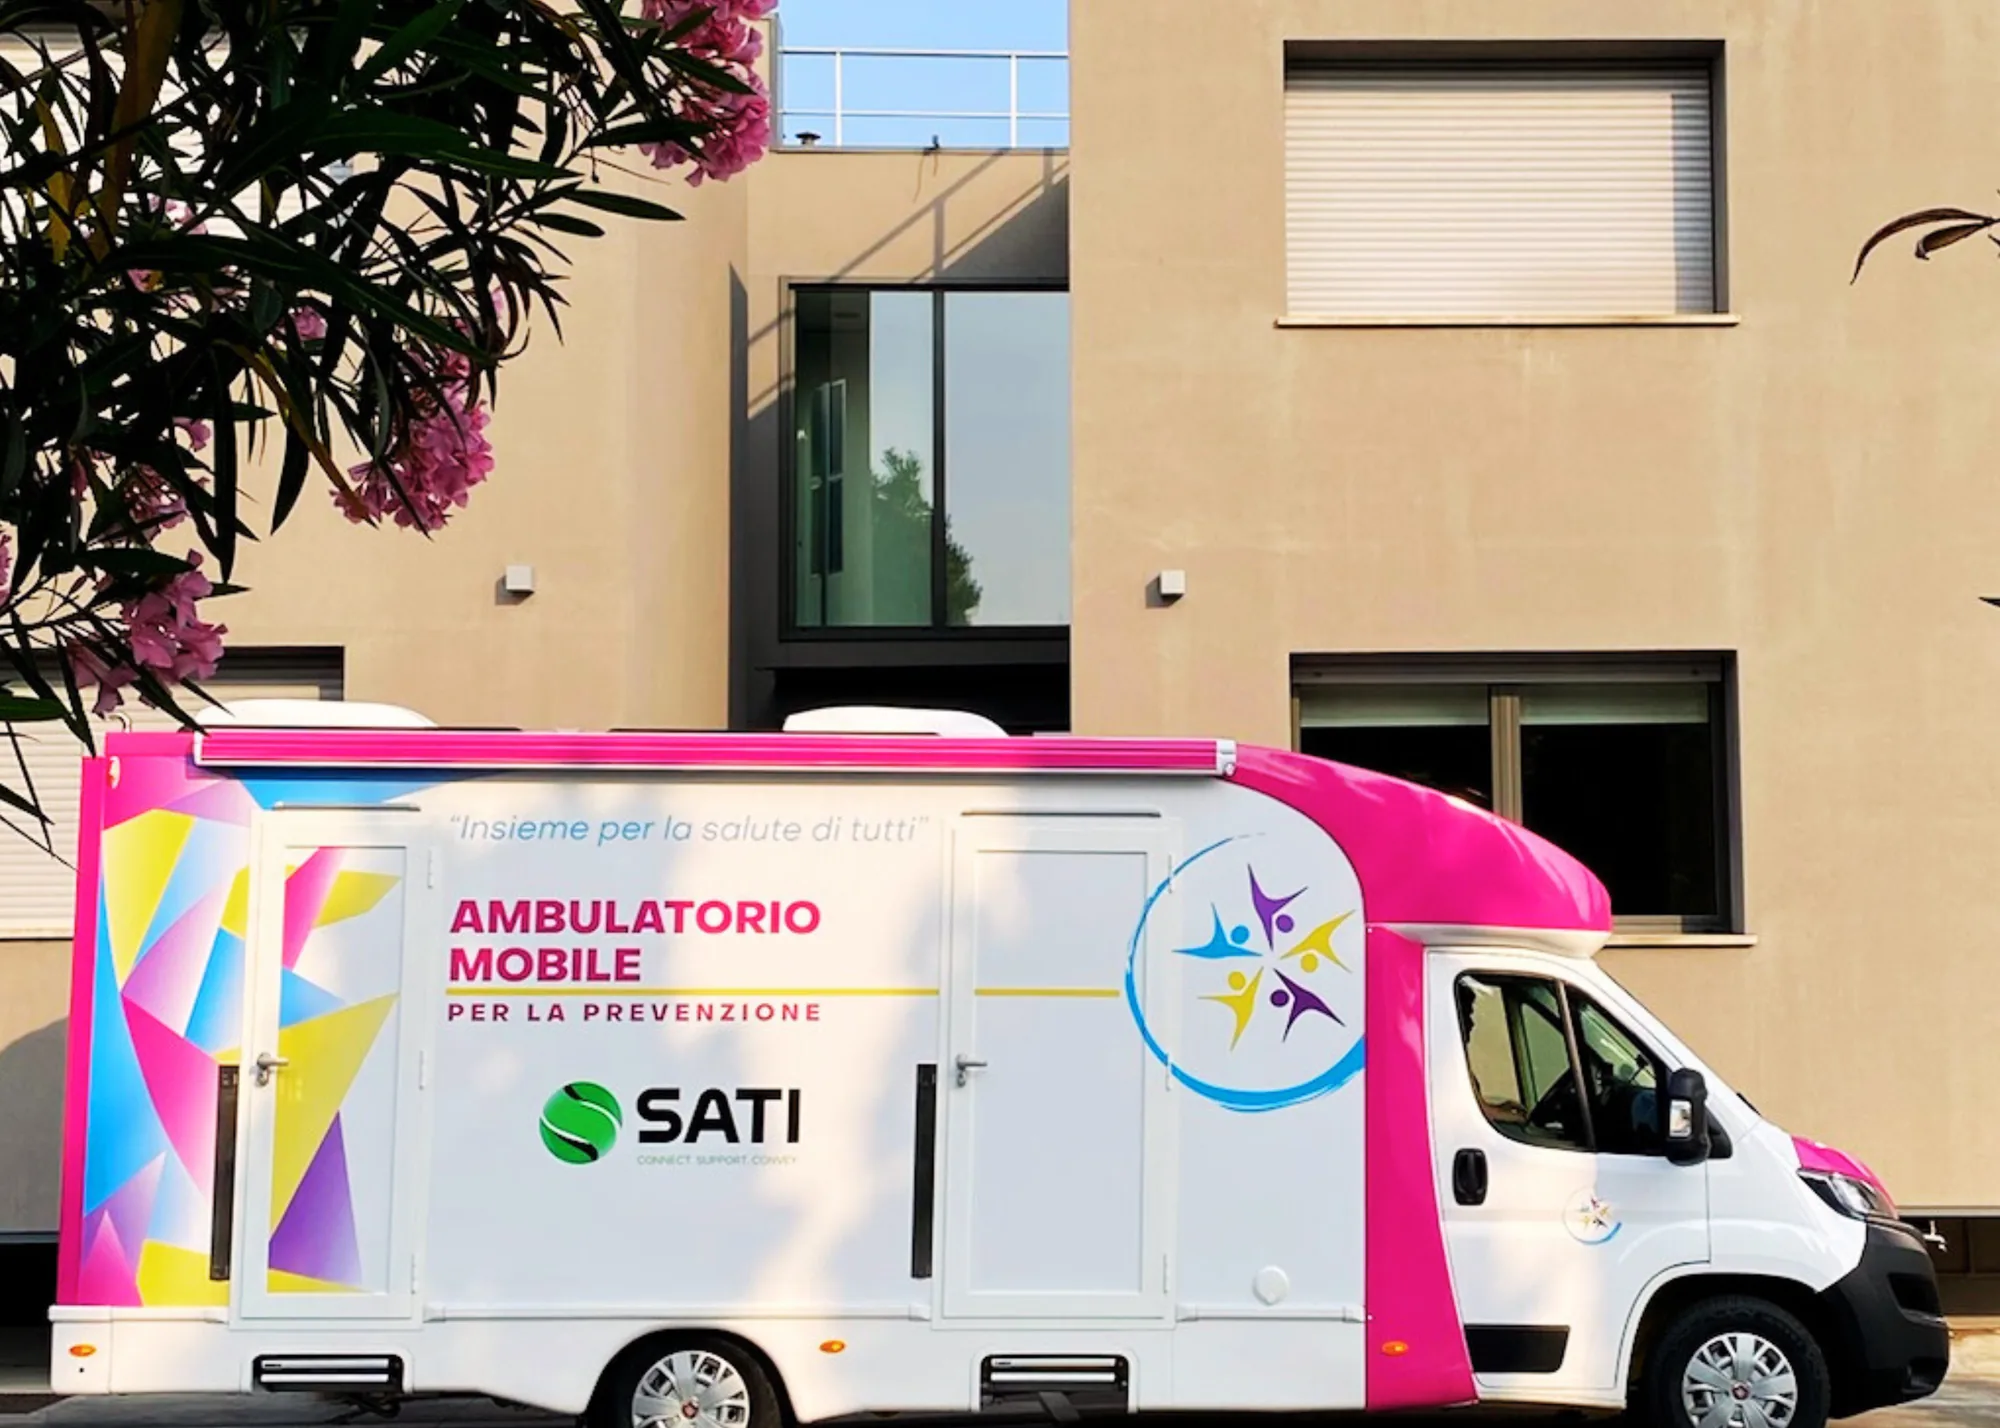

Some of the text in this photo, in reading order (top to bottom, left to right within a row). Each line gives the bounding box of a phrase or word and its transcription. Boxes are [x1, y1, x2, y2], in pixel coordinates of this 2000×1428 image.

[596, 819, 656, 848] per
[663, 814, 693, 841] la
[703, 814, 803, 842] salute
[812, 815, 843, 842] di
[449, 899, 821, 935] AMBULATORIO
[449, 947, 642, 983] MOBILE
[447, 1002, 821, 1022] PER LA PREVENZIONE
[635, 1087, 801, 1144] SATI
